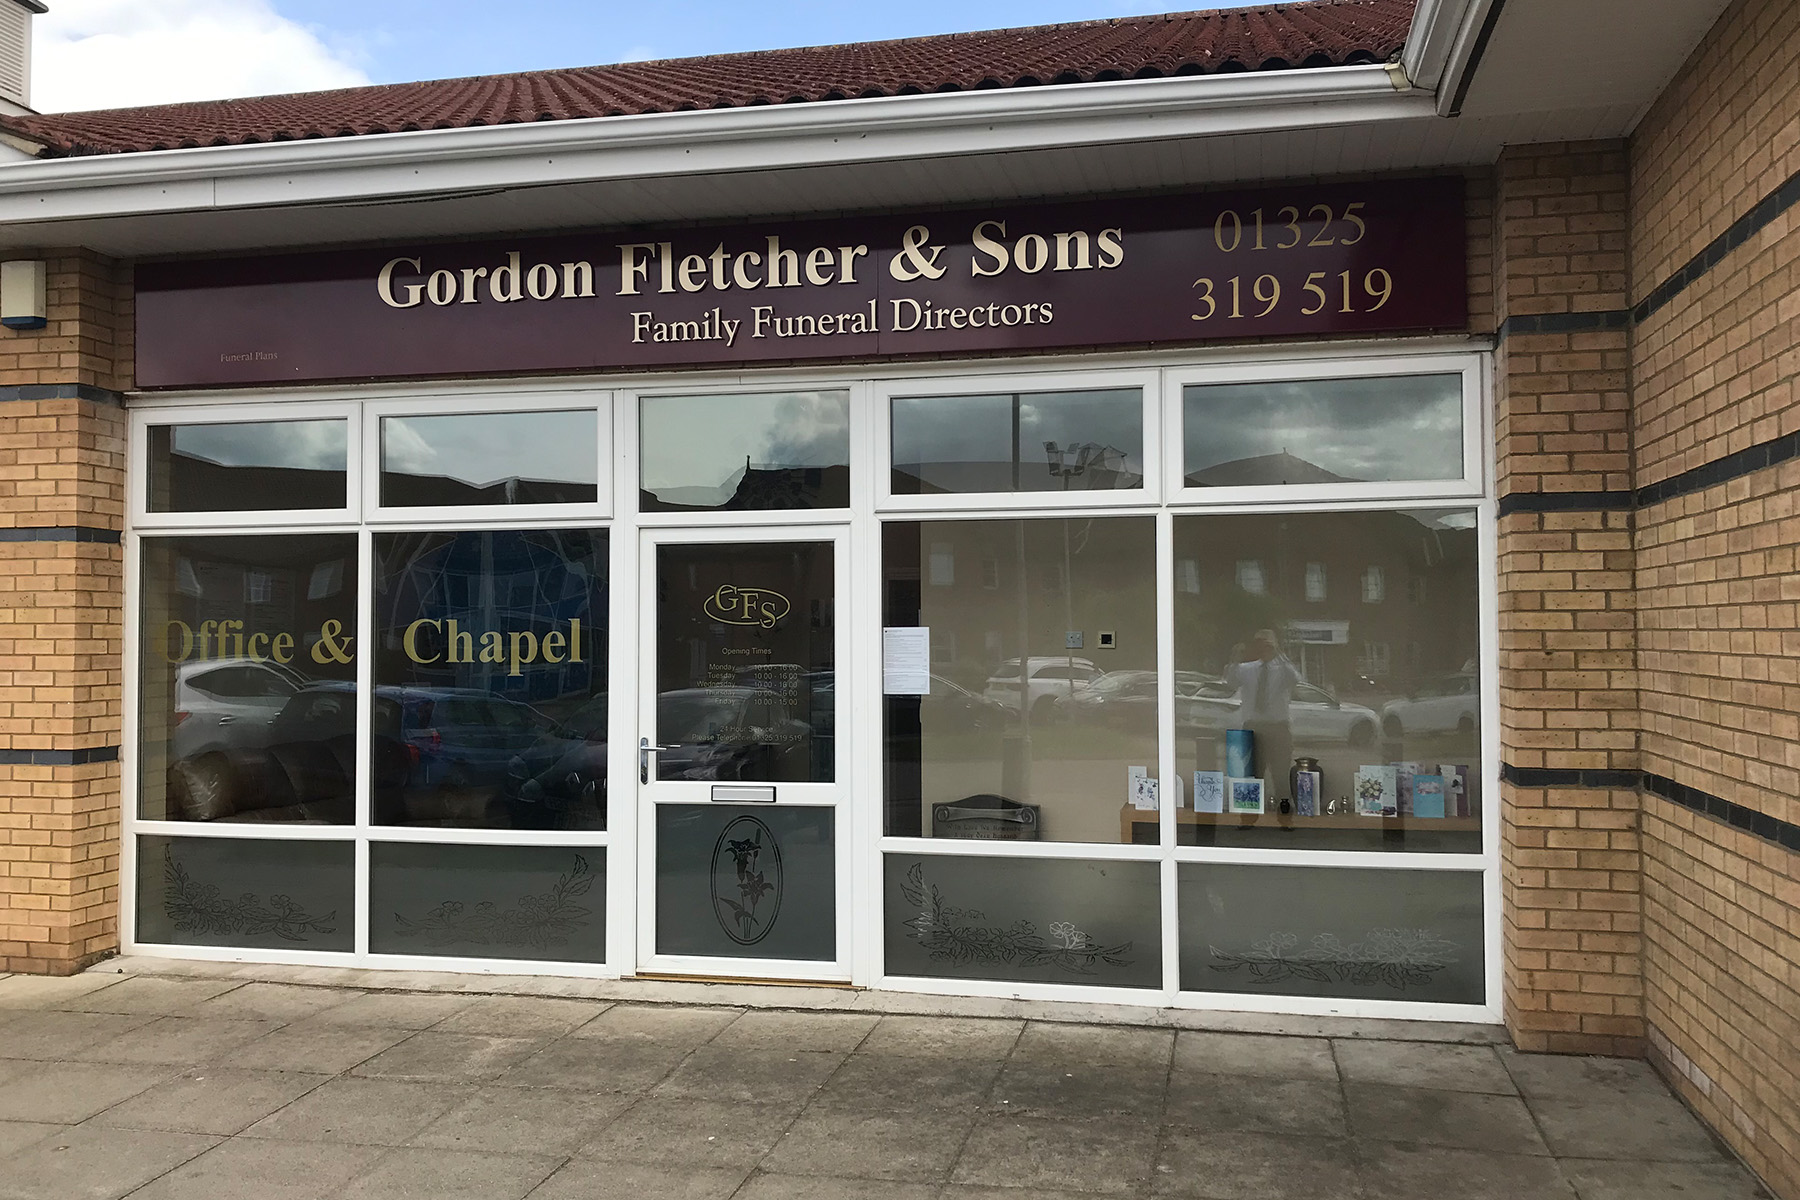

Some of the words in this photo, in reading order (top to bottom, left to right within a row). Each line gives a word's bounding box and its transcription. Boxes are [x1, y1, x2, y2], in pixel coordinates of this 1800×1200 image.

[1213, 202, 1366, 252] 01325
[377, 250, 597, 308] Gordon
[615, 235, 868, 296] Fletcher
[889, 225, 947, 282] &
[971, 219, 1124, 278] Sons
[1191, 274, 1281, 321] 319
[1300, 268, 1392, 315] 519
[630, 307, 740, 347] Family
[751, 299, 879, 338] Funeral
[890, 298, 1053, 332] Directors
[220, 352, 253, 363] Funeral
[255, 351, 278, 361] Plans
[715, 584, 777, 629] GFS
[159, 619, 295, 664] Office
[310, 619, 355, 665] &
[403, 618, 584, 677] Chapel
[721, 647, 750, 656] Opening
[752, 647, 772, 655] Times
[708, 663, 736, 672] Monday
[707, 671, 736, 680] Tuesday
[754, 672, 773, 680] 1000
[779, 672, 798, 680] 1600
[696, 680, 736, 688] Wednesday
[705, 689, 736, 697] Thursday
[714, 697, 736, 706] Friday
[754, 698, 773, 706] 1000
[779, 698, 798, 706] 1500
[748, 725, 774, 733] Servce
[691, 733, 715, 741] Please
[716, 733, 751, 742] Telepho
